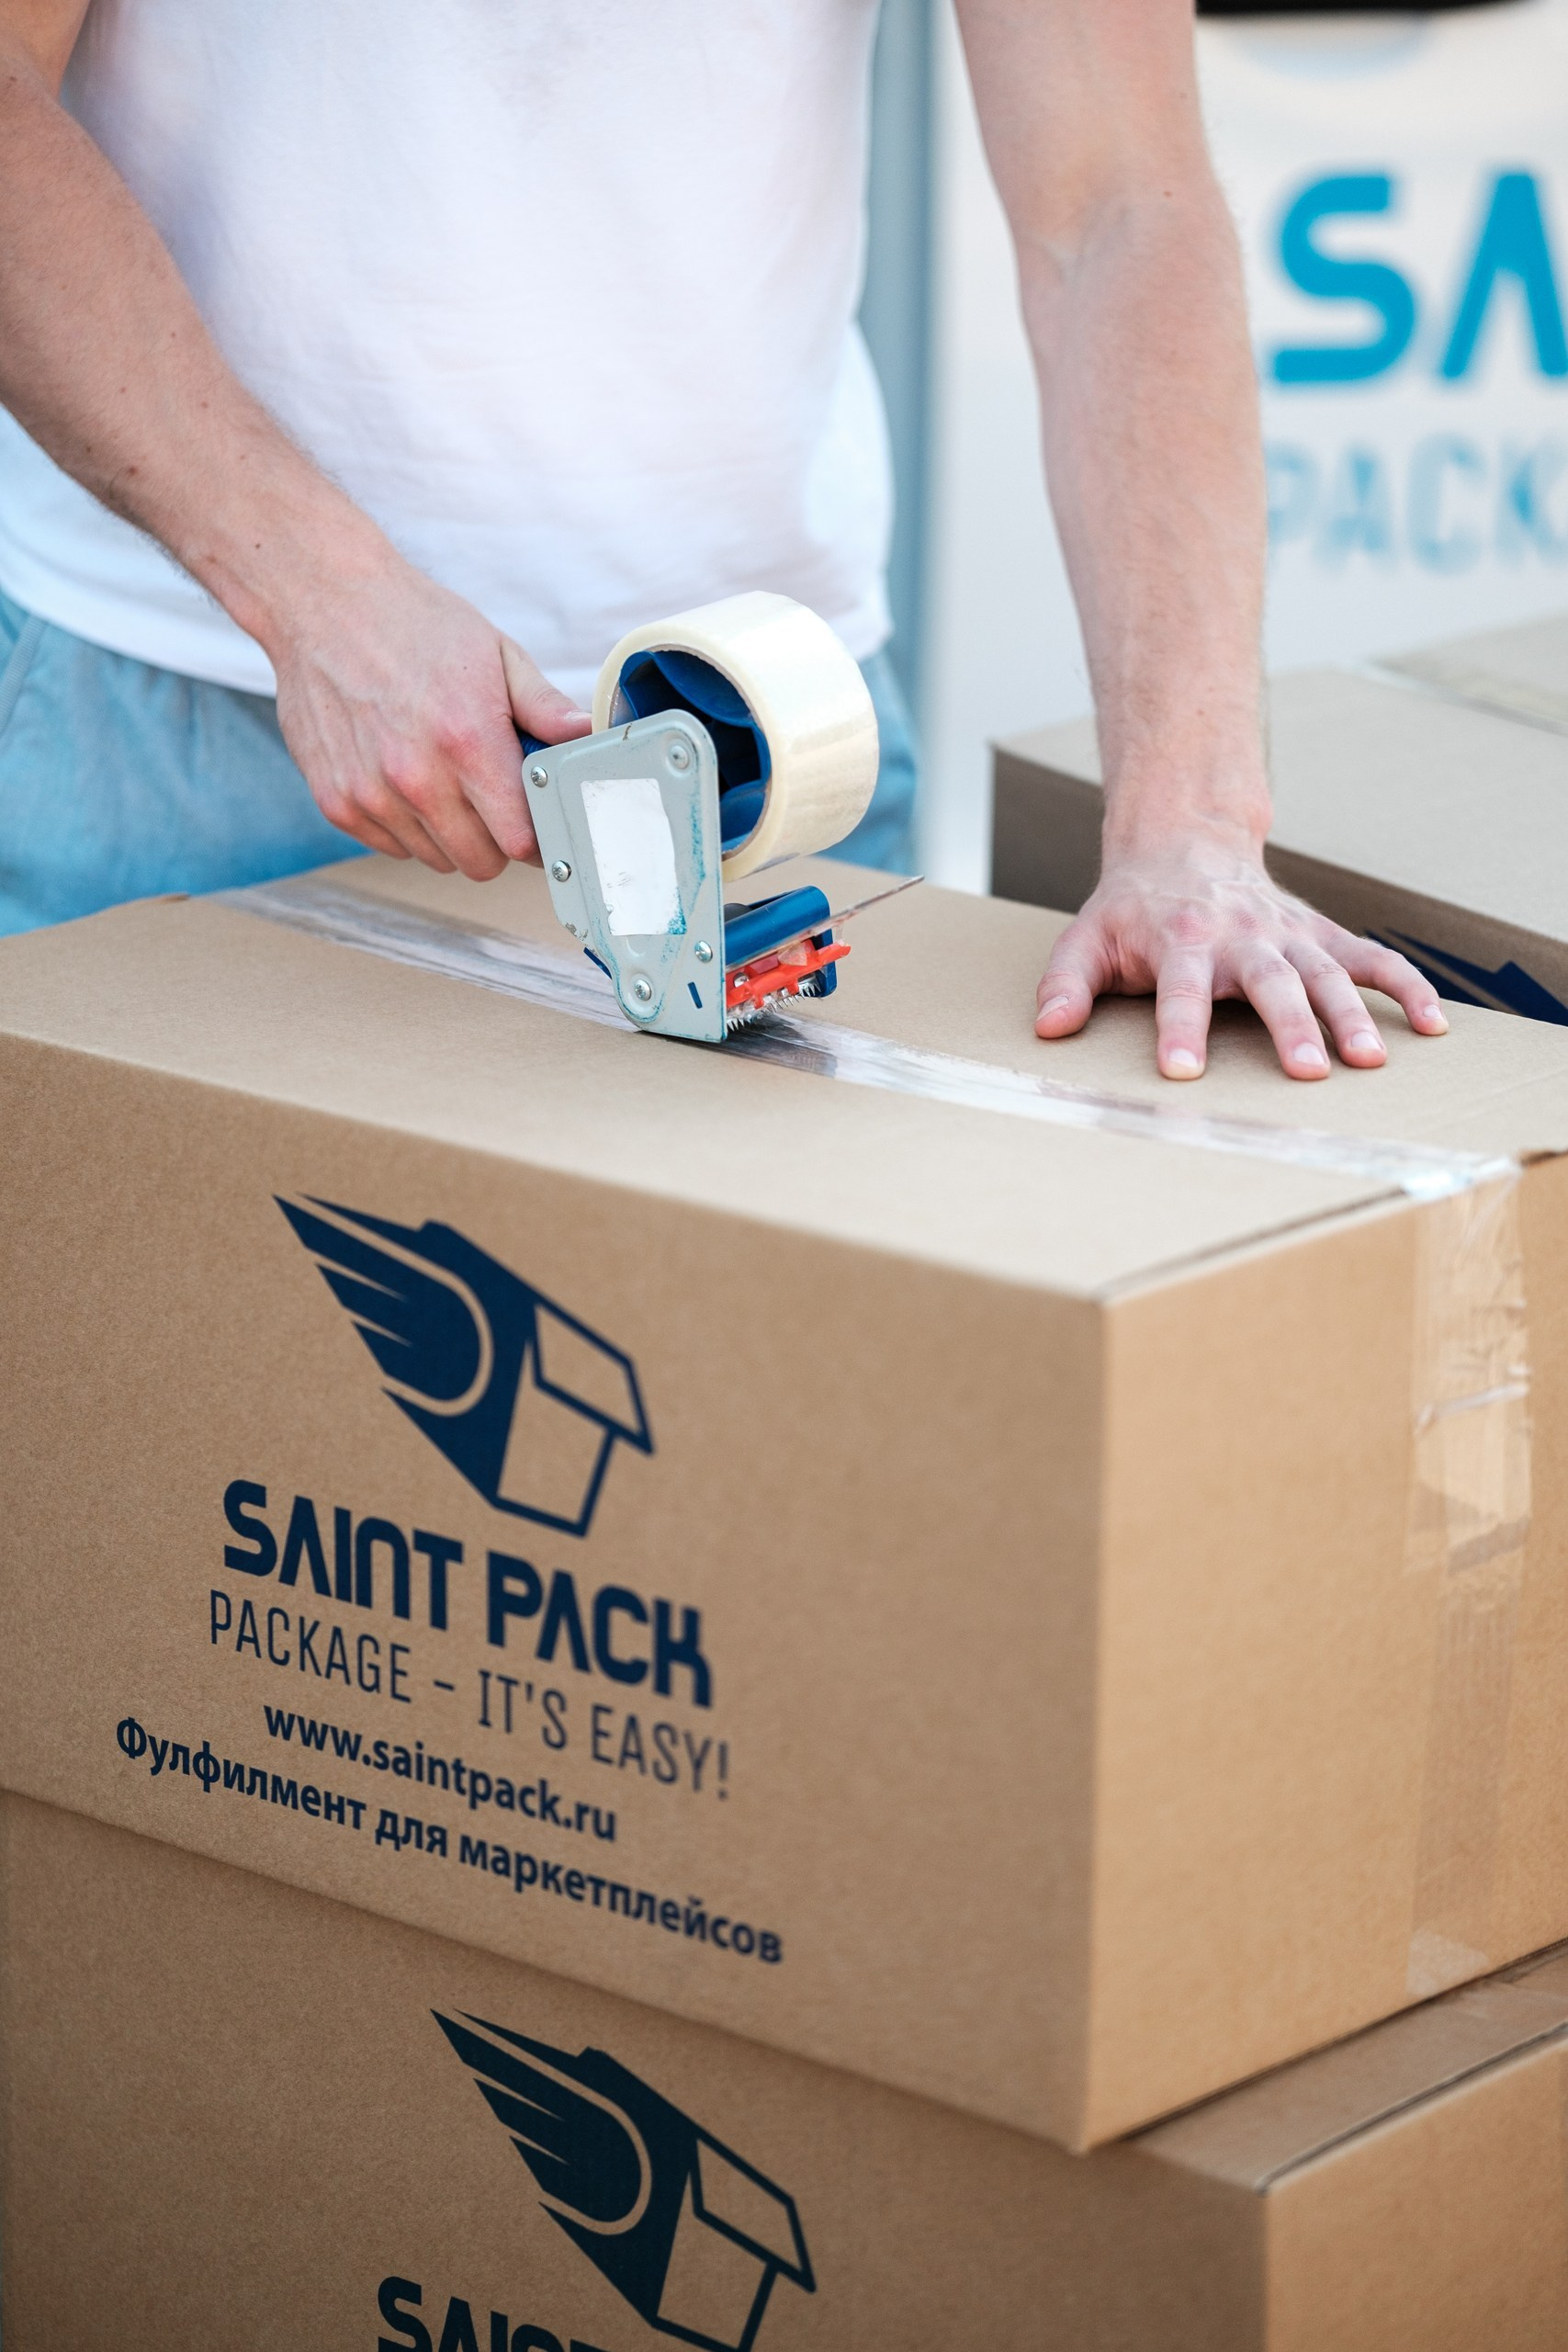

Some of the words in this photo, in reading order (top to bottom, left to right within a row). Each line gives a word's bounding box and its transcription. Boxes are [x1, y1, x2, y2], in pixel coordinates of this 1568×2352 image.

[209, 1589, 412, 1704] PACKAGE
[478, 1669, 568, 1751] IT'S
[591, 1703, 730, 1800] EASY!
[223, 1479, 464, 1632] SAINT
[487, 1550, 713, 1709] PACK
[116, 1715, 367, 1831] Фулфилмент
[375, 1807, 448, 1859] для
[458, 1834, 784, 1964] маркетплейсов
[263, 1704, 617, 1842] www.saintpack.ru
